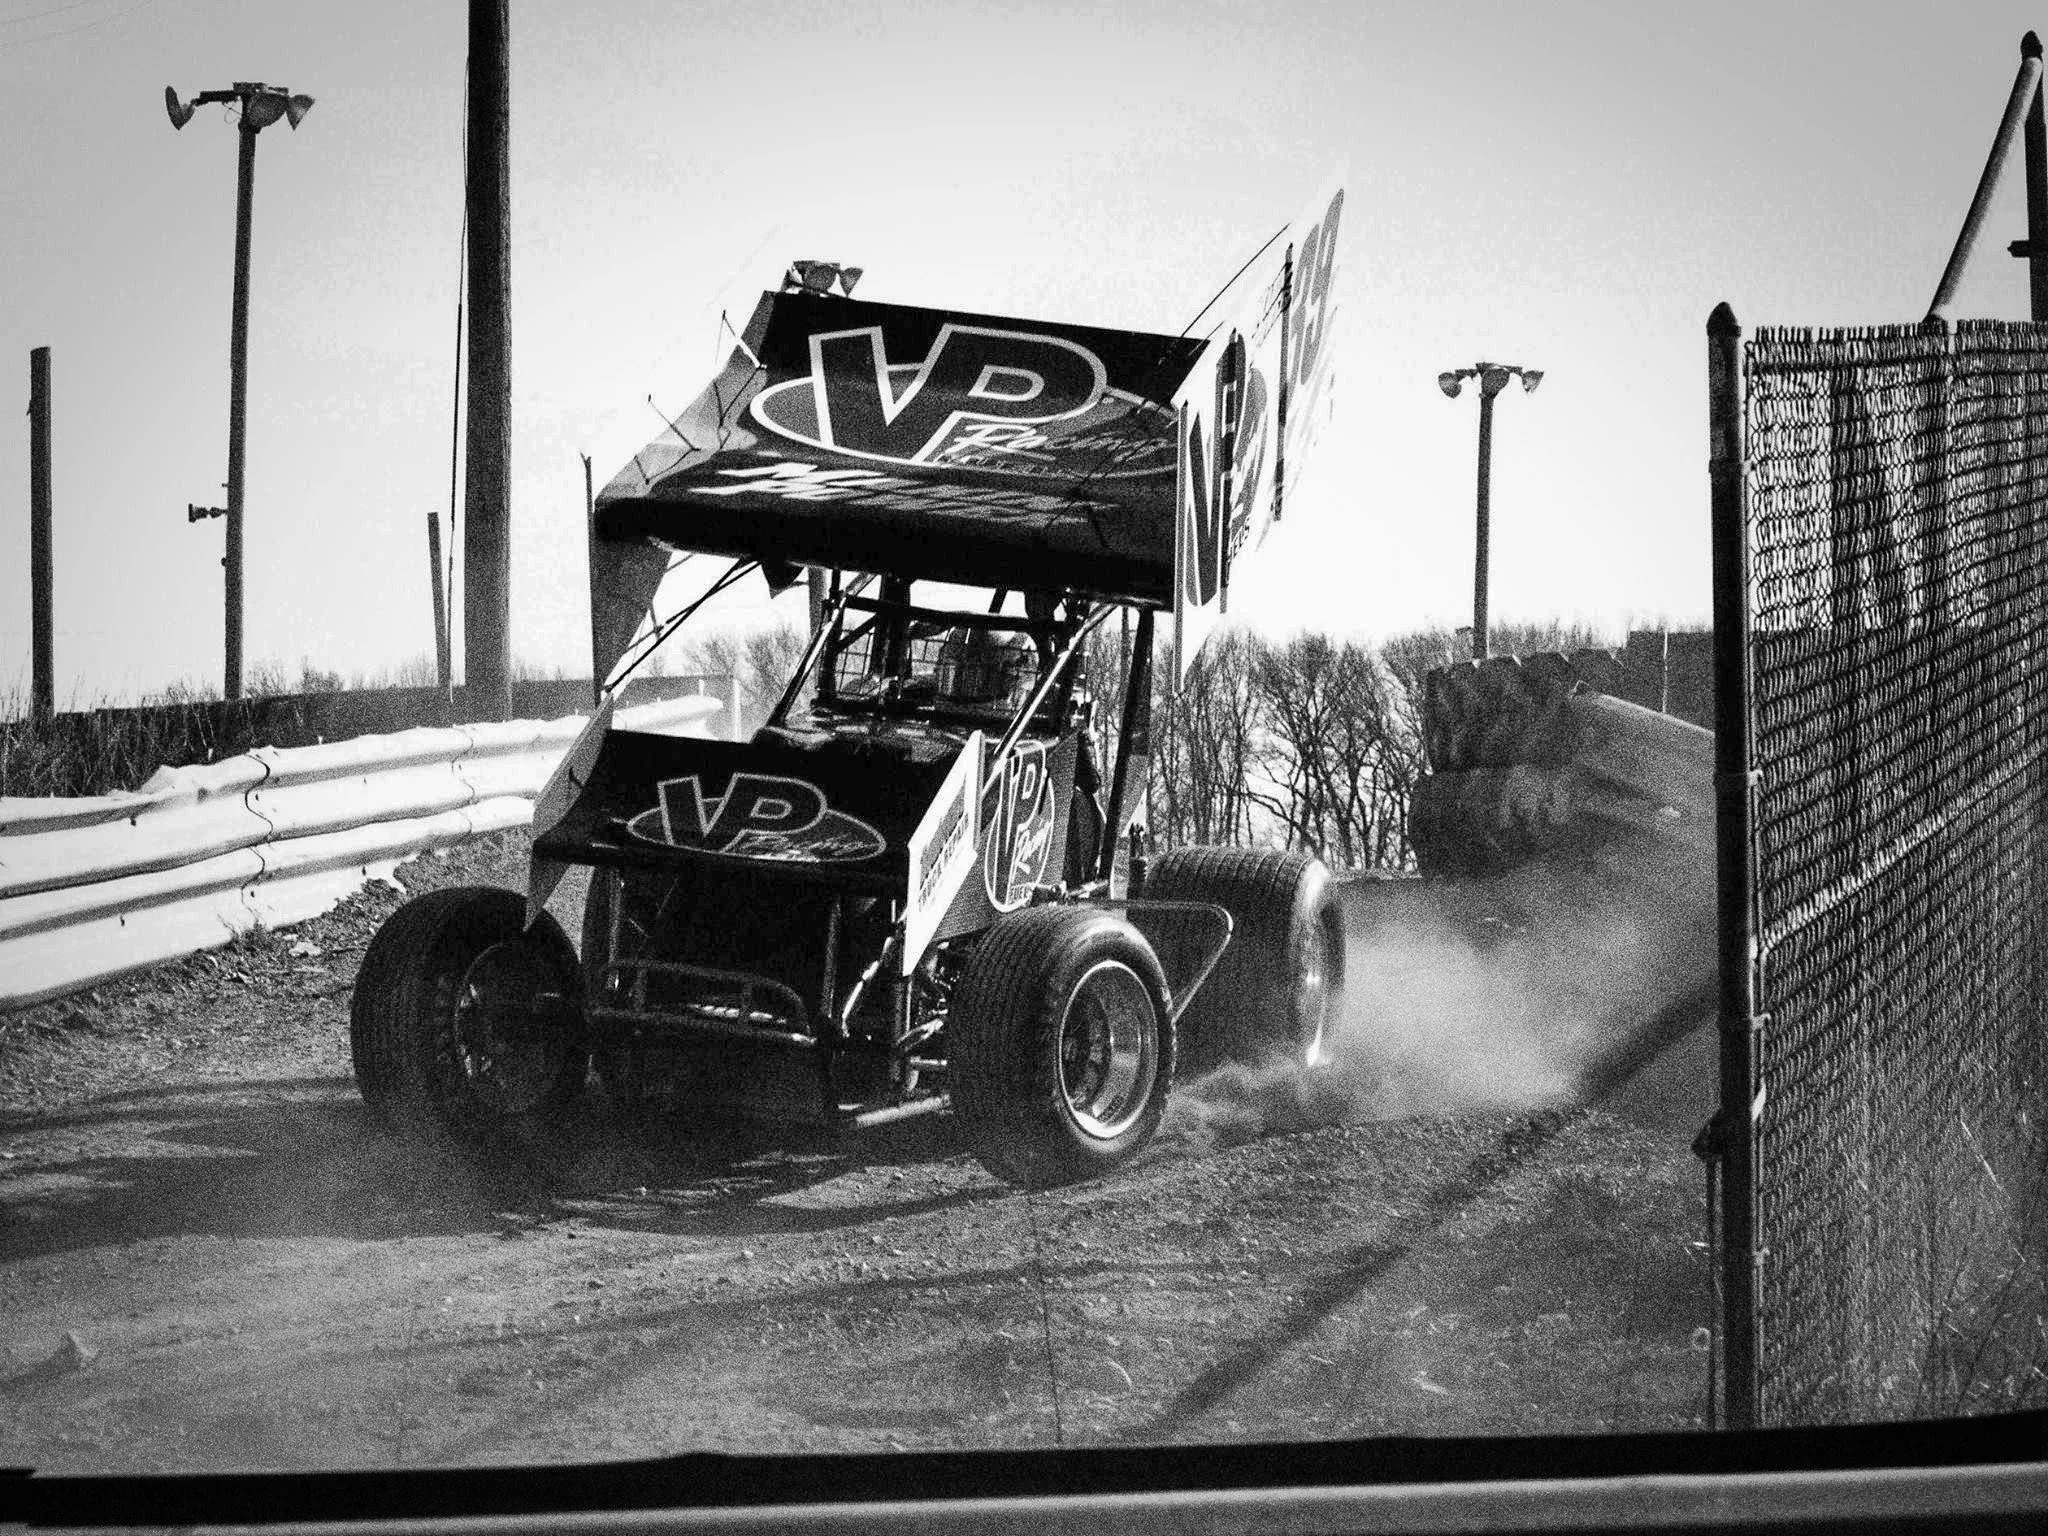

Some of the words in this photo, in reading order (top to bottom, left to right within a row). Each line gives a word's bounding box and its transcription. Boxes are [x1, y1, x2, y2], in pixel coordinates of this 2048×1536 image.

[808, 322, 1108, 466] VP
[657, 772, 827, 853] VP
[993, 740, 1047, 906] VP
